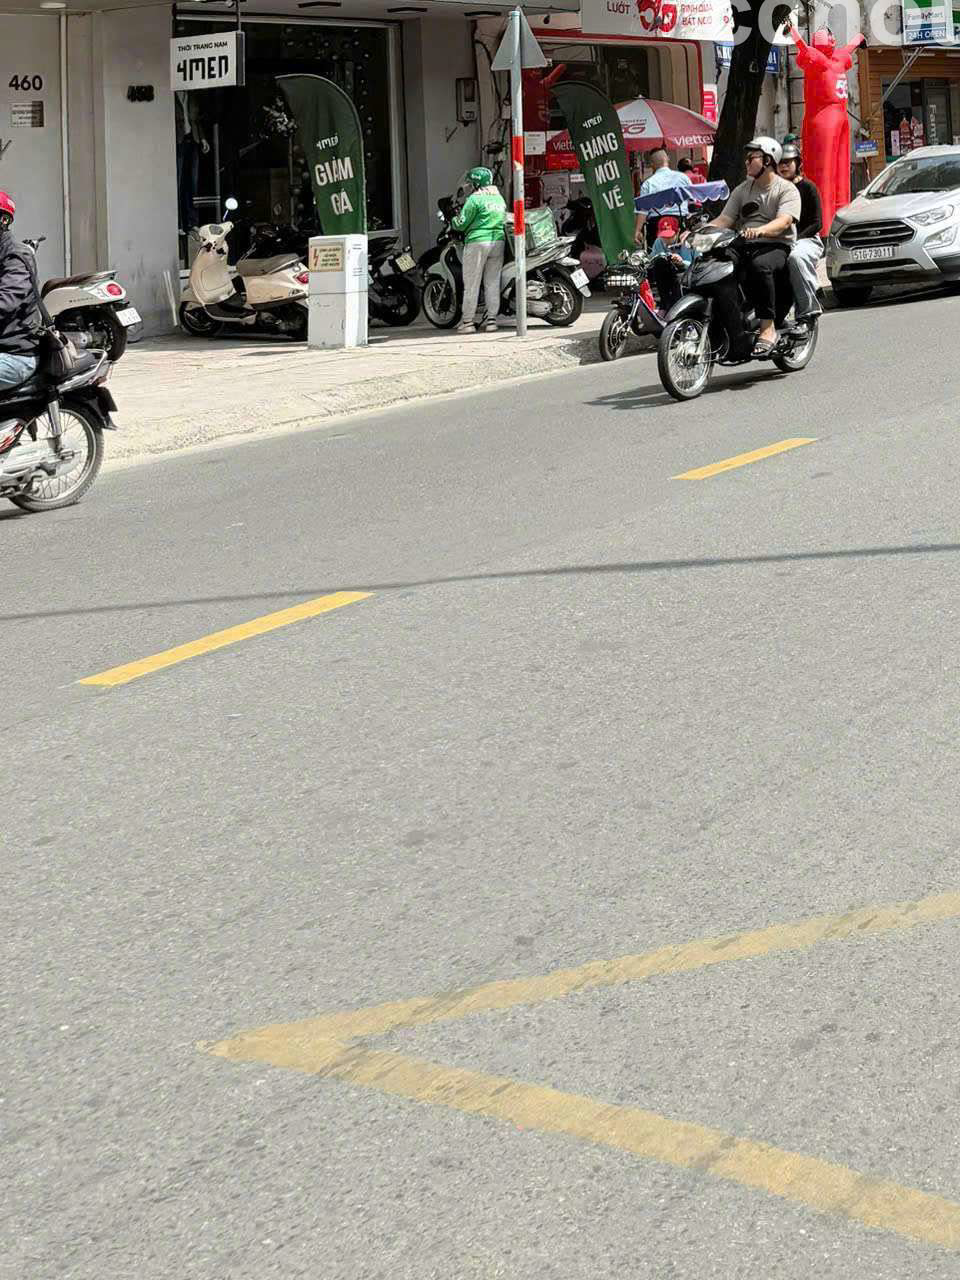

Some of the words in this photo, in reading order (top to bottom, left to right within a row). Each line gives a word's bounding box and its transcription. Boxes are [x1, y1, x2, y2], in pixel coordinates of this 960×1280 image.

[607, 0, 630, 15] LƯỚT
[908, 32, 922, 40] 24H
[925, 29, 945, 38] OPEN
[193, 42, 212, 50] TRANG
[177, 55, 229, 82] 4MEN
[9, 75, 43, 91] 460
